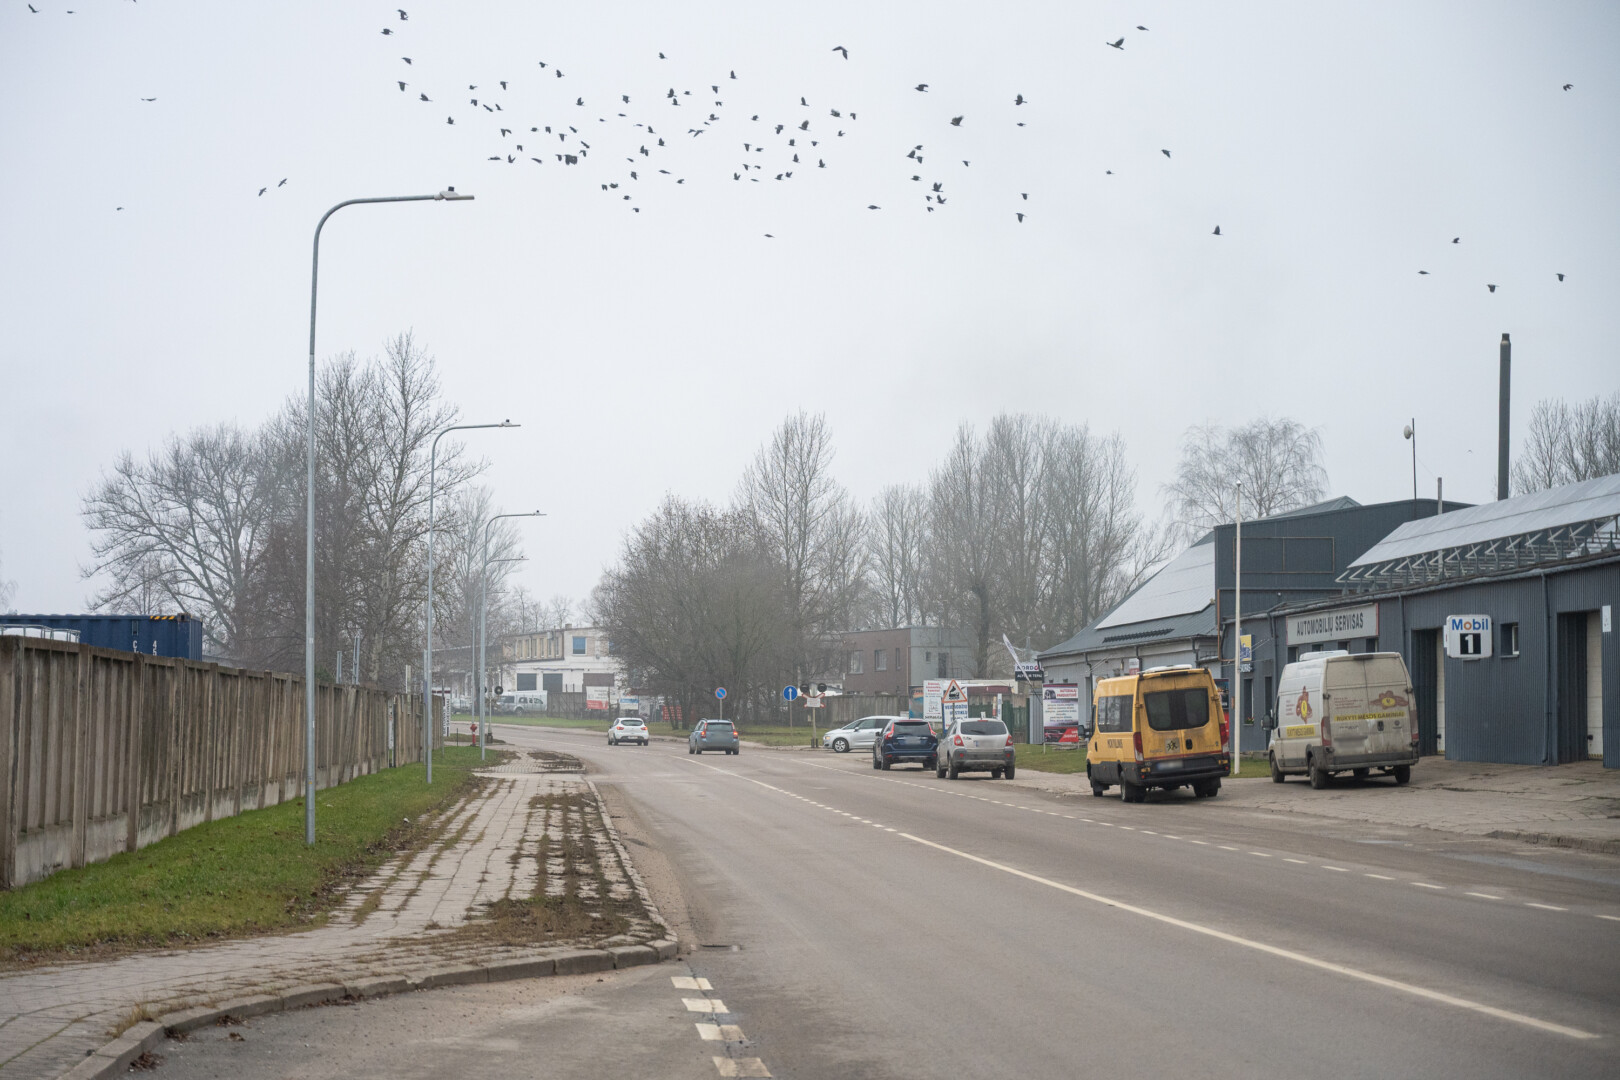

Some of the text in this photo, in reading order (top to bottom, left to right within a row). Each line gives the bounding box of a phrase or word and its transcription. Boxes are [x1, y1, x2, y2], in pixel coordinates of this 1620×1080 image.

[1297, 612, 1364, 637] AUTOMOBILIŲ SERVISAS
[1451, 618, 1489, 631] Mobil
[1464, 634, 1474, 654] 1
